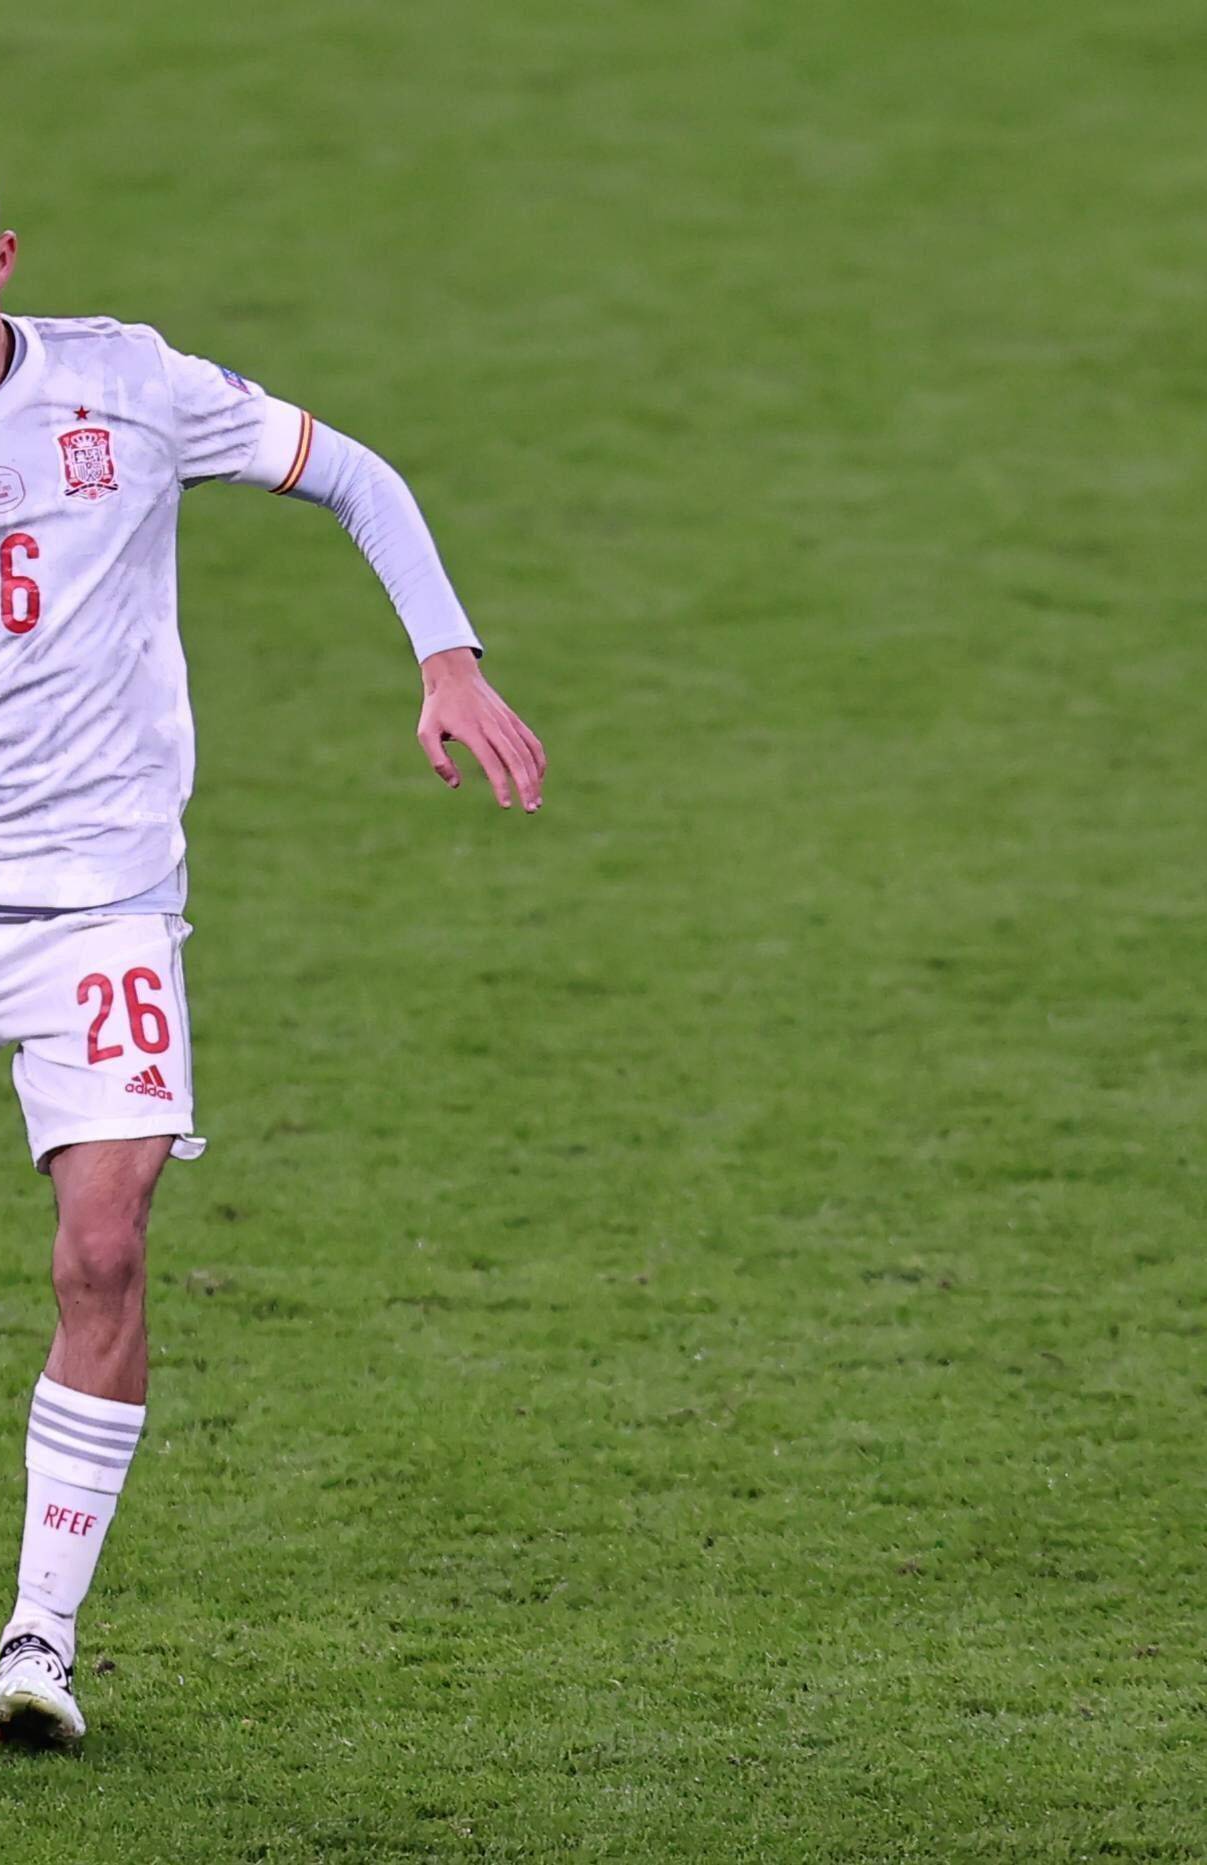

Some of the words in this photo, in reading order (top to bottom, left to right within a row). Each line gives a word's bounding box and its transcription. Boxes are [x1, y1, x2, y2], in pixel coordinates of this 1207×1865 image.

[77, 967, 170, 1065] 26
[125, 1083, 173, 1101] adidas
[43, 1504, 97, 1536] RFEF
